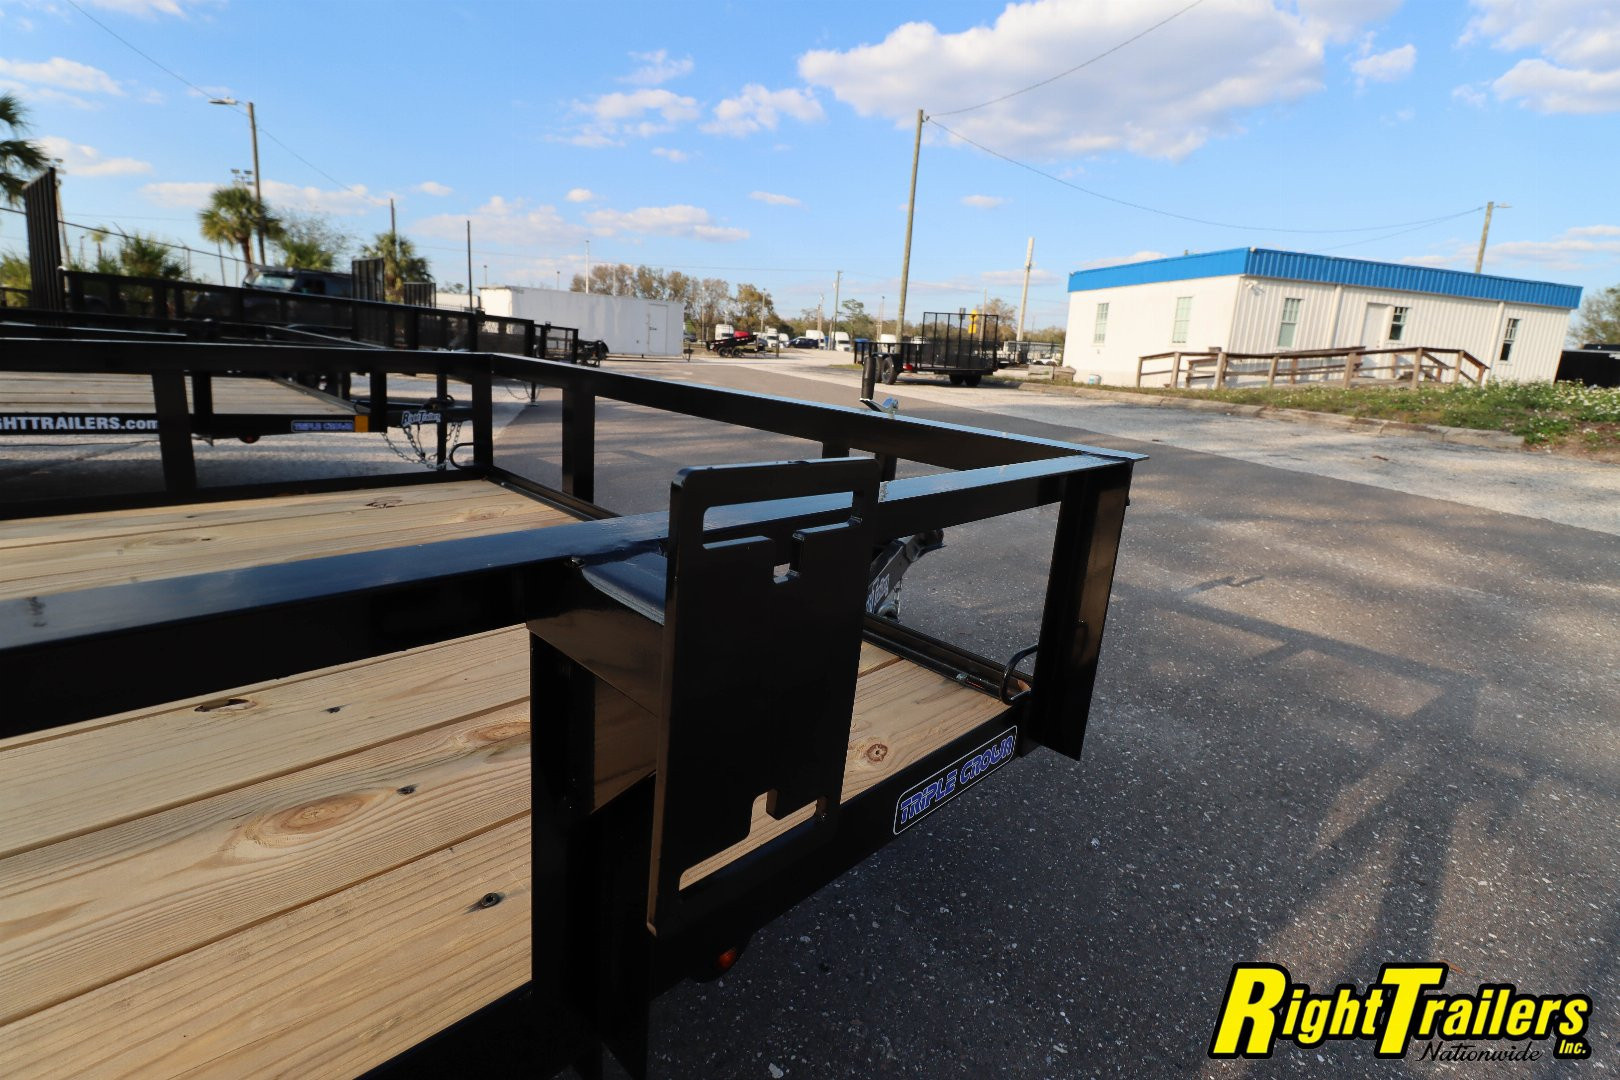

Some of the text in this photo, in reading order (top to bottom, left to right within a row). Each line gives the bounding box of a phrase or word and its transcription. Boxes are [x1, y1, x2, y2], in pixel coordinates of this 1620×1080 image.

[0, 416, 158, 430] HTTRAILERS.com
[900, 735, 1014, 825] TRIPLE CROWN
